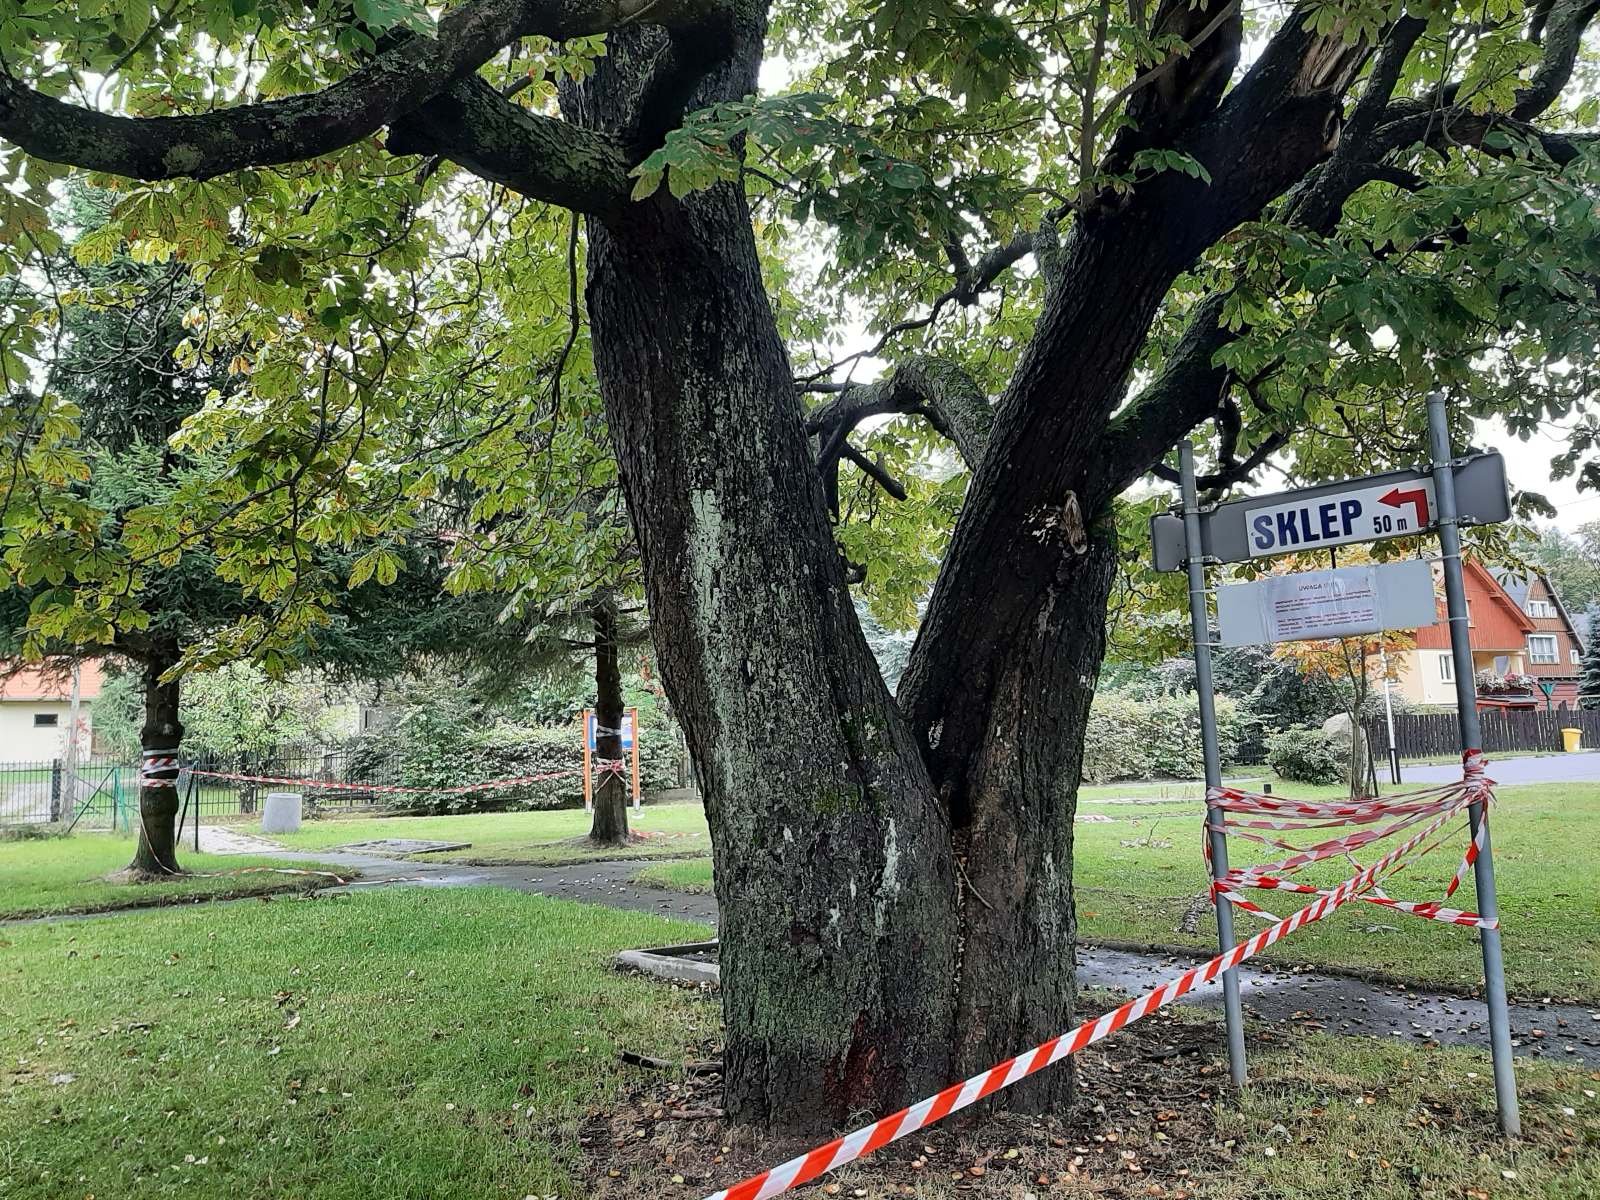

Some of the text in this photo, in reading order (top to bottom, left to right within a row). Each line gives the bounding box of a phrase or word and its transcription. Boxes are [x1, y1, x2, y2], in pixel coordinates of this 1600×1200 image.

[1253, 499, 1362, 550] SKLEP
[1373, 514, 1408, 534] 50 m
[1298, 583, 1323, 592] UWAGA
